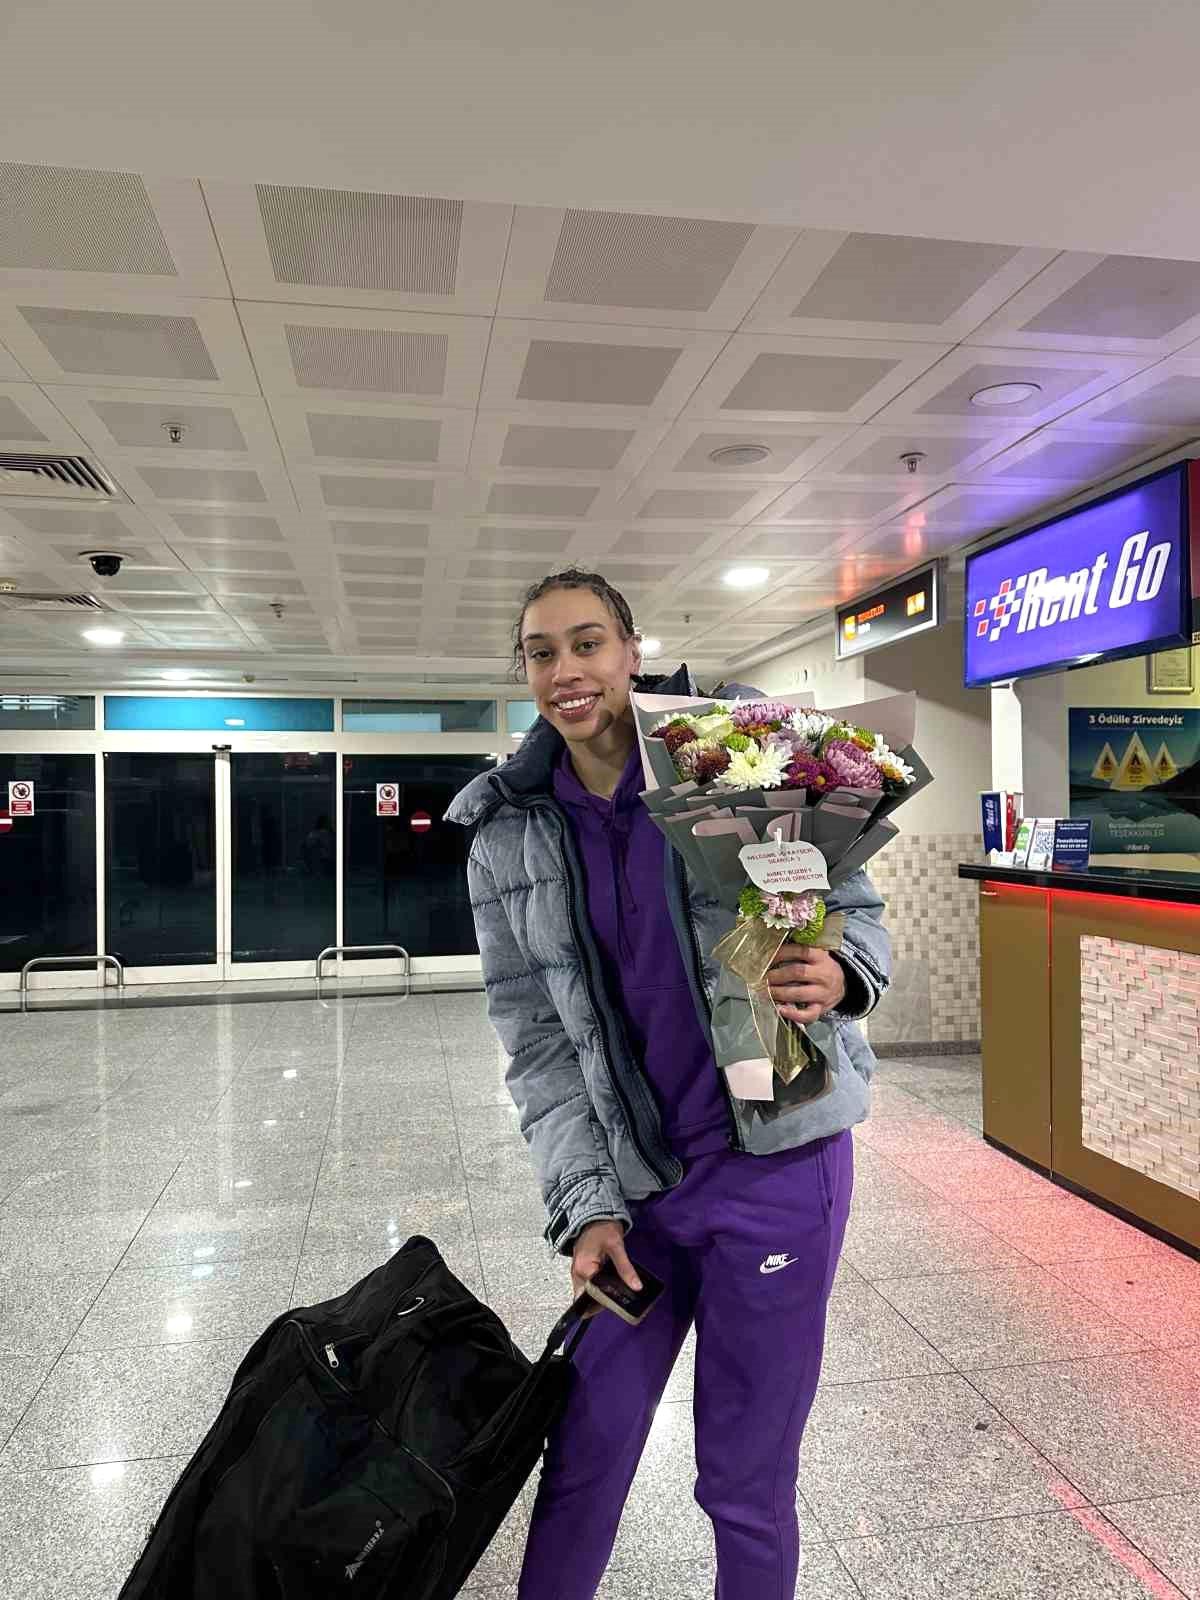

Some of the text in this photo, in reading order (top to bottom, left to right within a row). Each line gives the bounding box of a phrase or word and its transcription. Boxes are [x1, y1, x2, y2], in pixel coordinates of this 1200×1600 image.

[1016, 531, 1171, 634] Rent Go
[1089, 712, 1183, 726] 3 Ödülle Zirvedeyiz
[766, 1253, 789, 1266] NIKE
